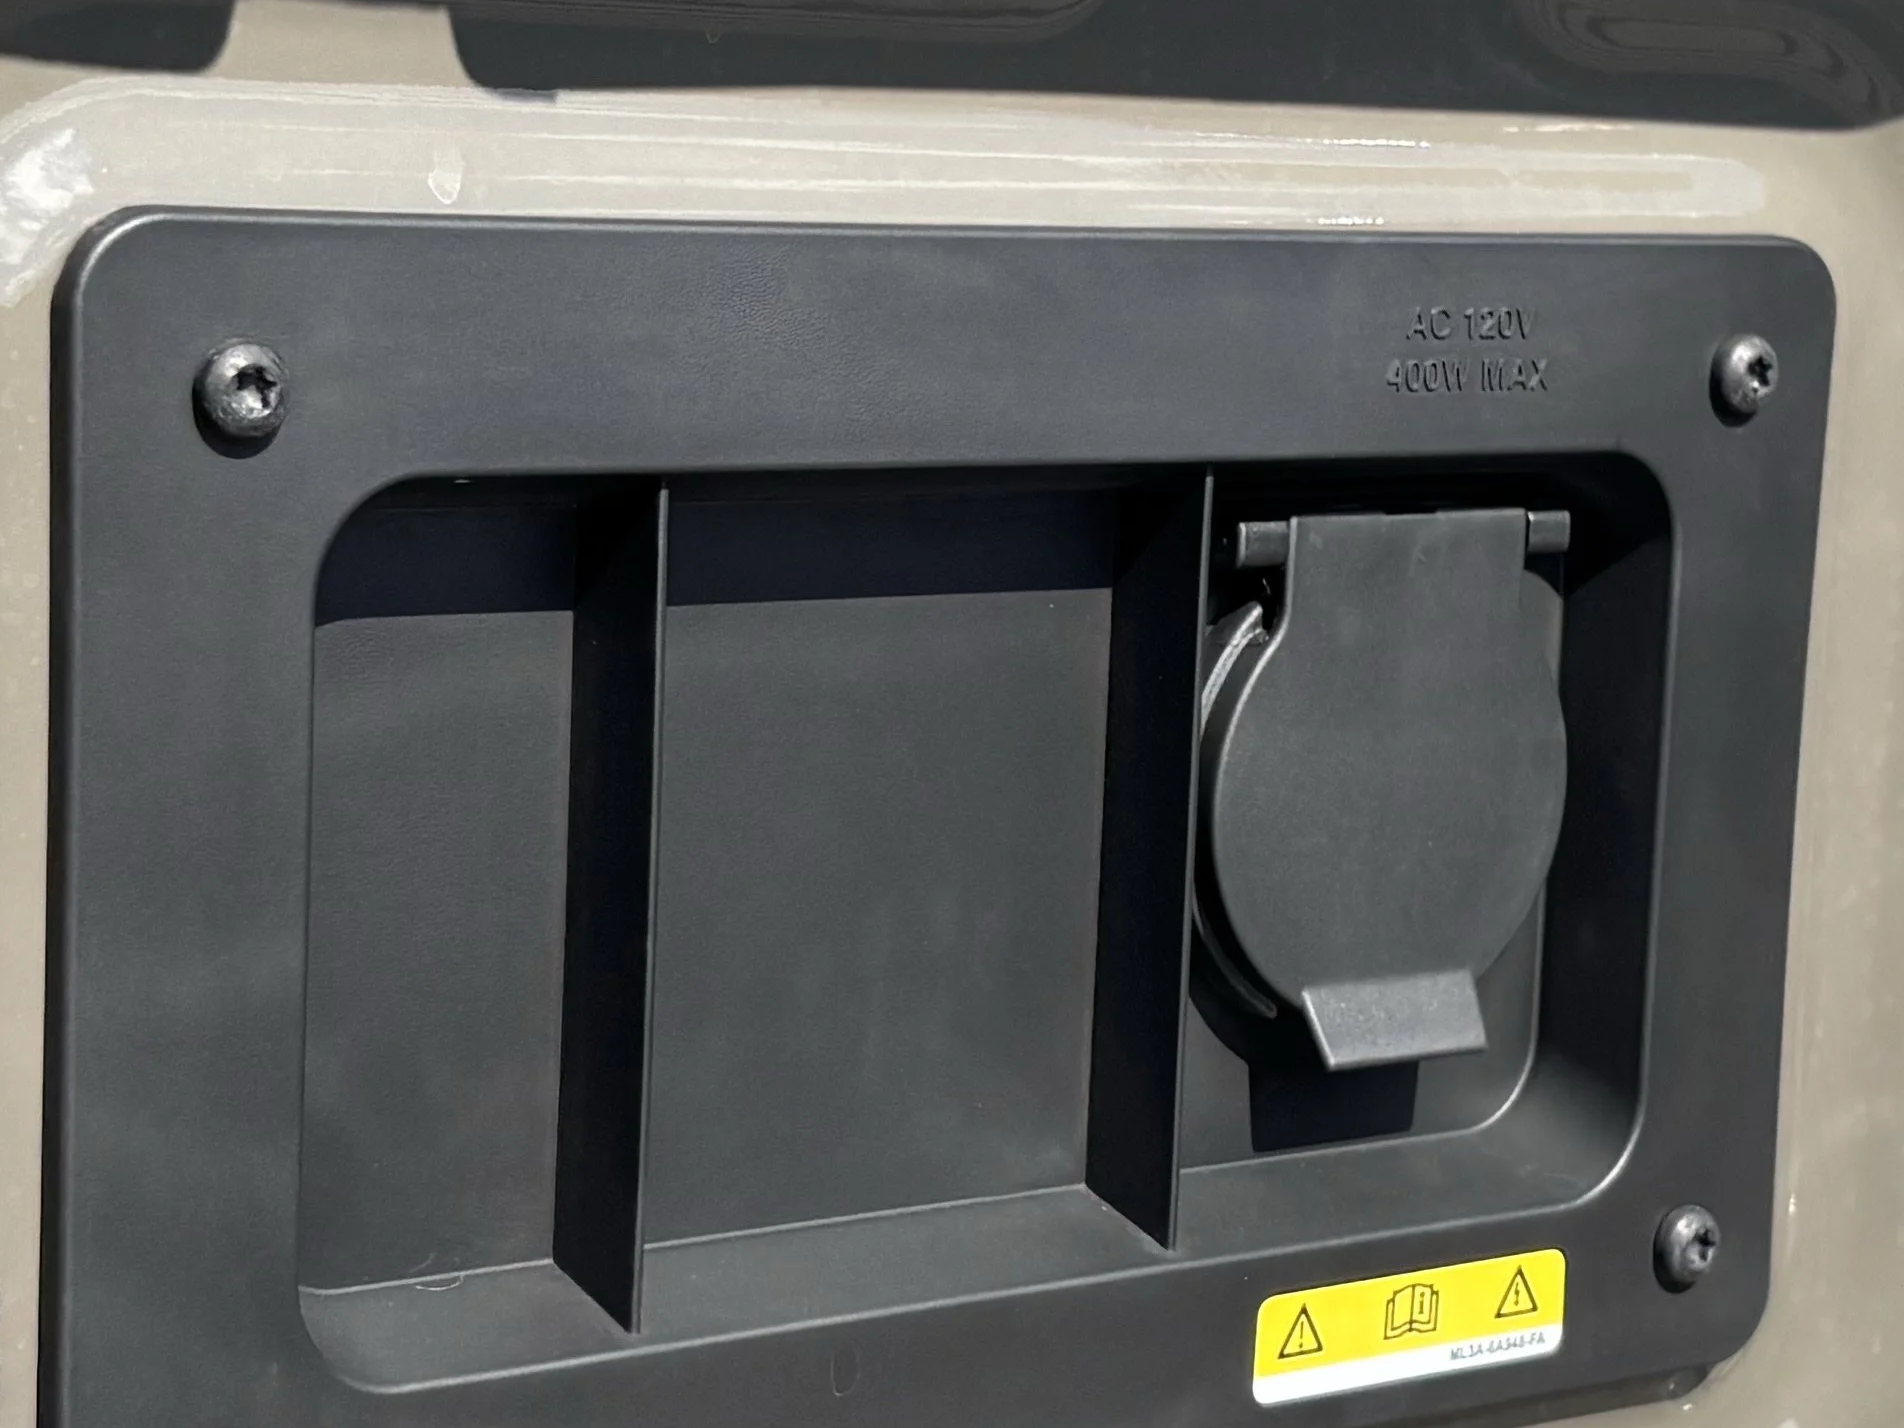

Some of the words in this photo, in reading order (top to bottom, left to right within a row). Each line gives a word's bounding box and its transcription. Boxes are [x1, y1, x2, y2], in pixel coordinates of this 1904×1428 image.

[1406, 306, 1451, 340] AC
[1462, 307, 1534, 341] 120V
[1386, 359, 1469, 393] 400W
[1481, 358, 1548, 392] MAX
